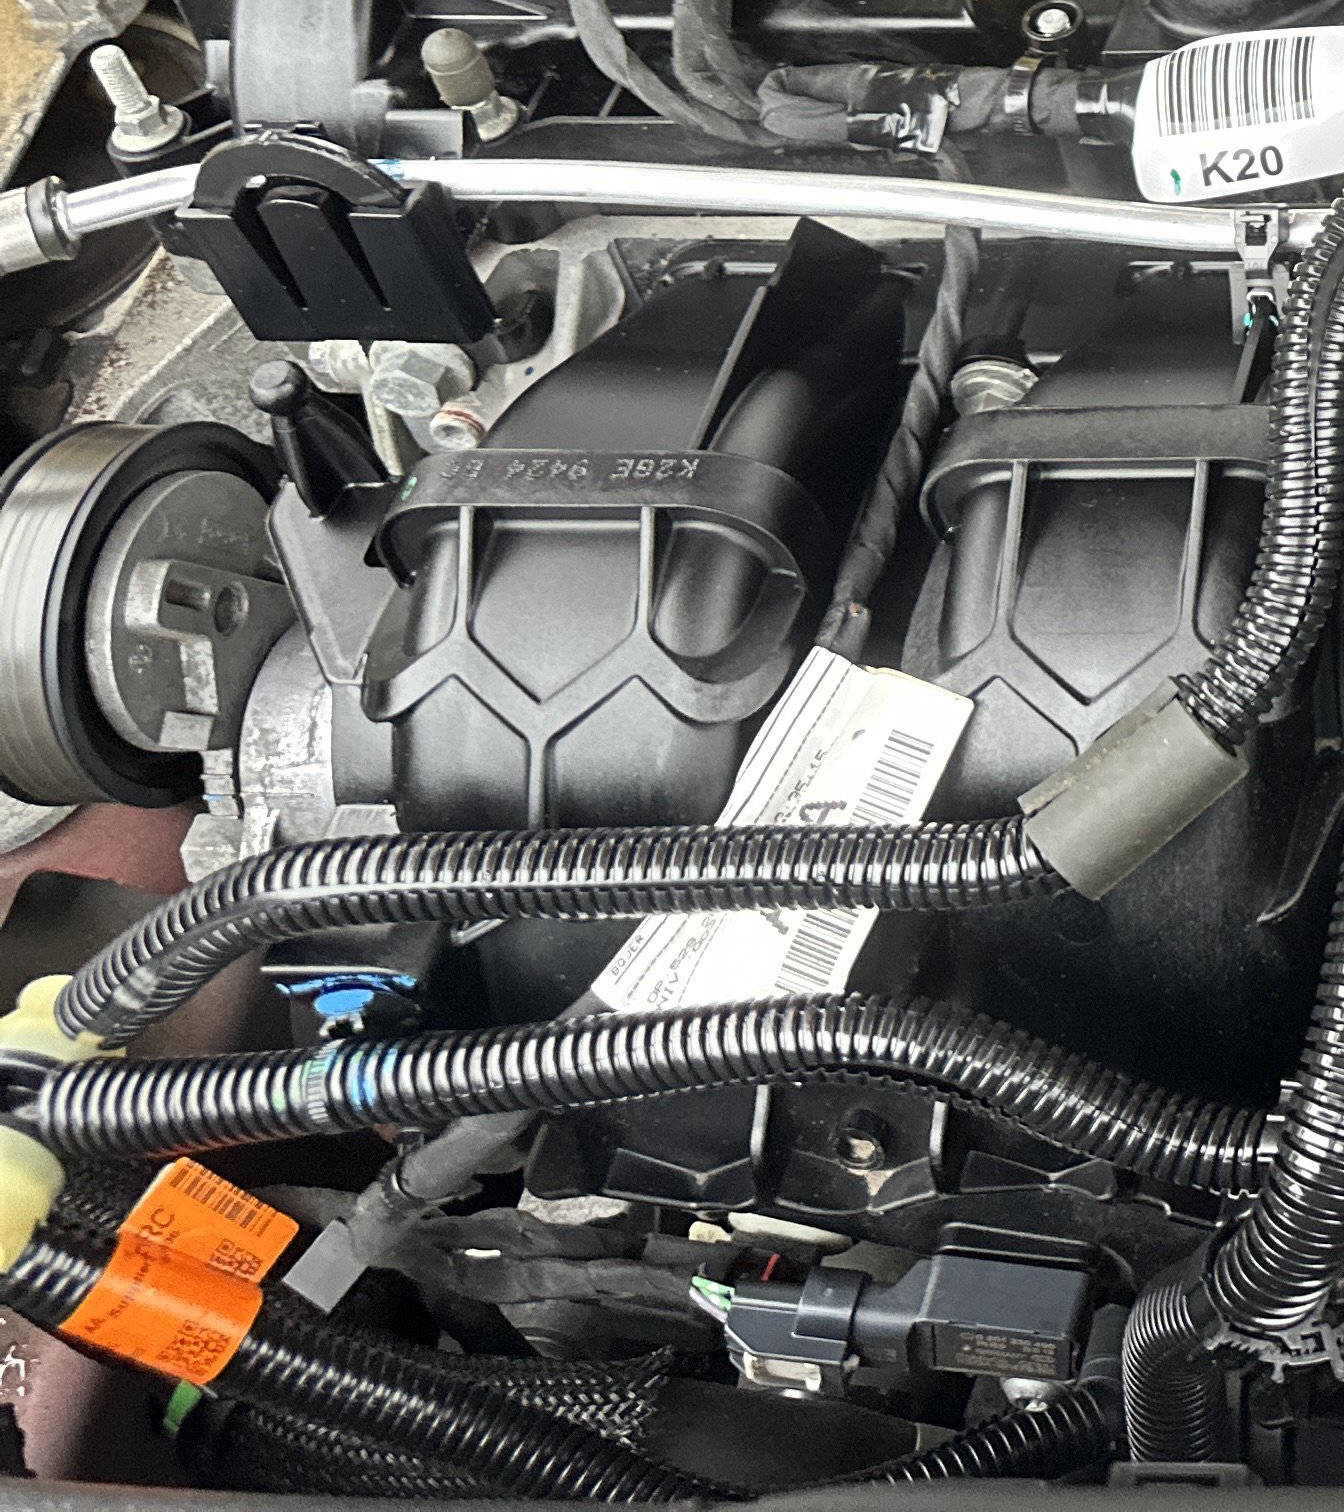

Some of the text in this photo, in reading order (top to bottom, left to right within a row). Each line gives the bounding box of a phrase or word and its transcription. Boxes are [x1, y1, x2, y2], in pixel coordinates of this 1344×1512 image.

[1199, 145, 1284, 187] K20
[503, 458, 589, 481] 9424
[609, 457, 700, 481] K2GE
